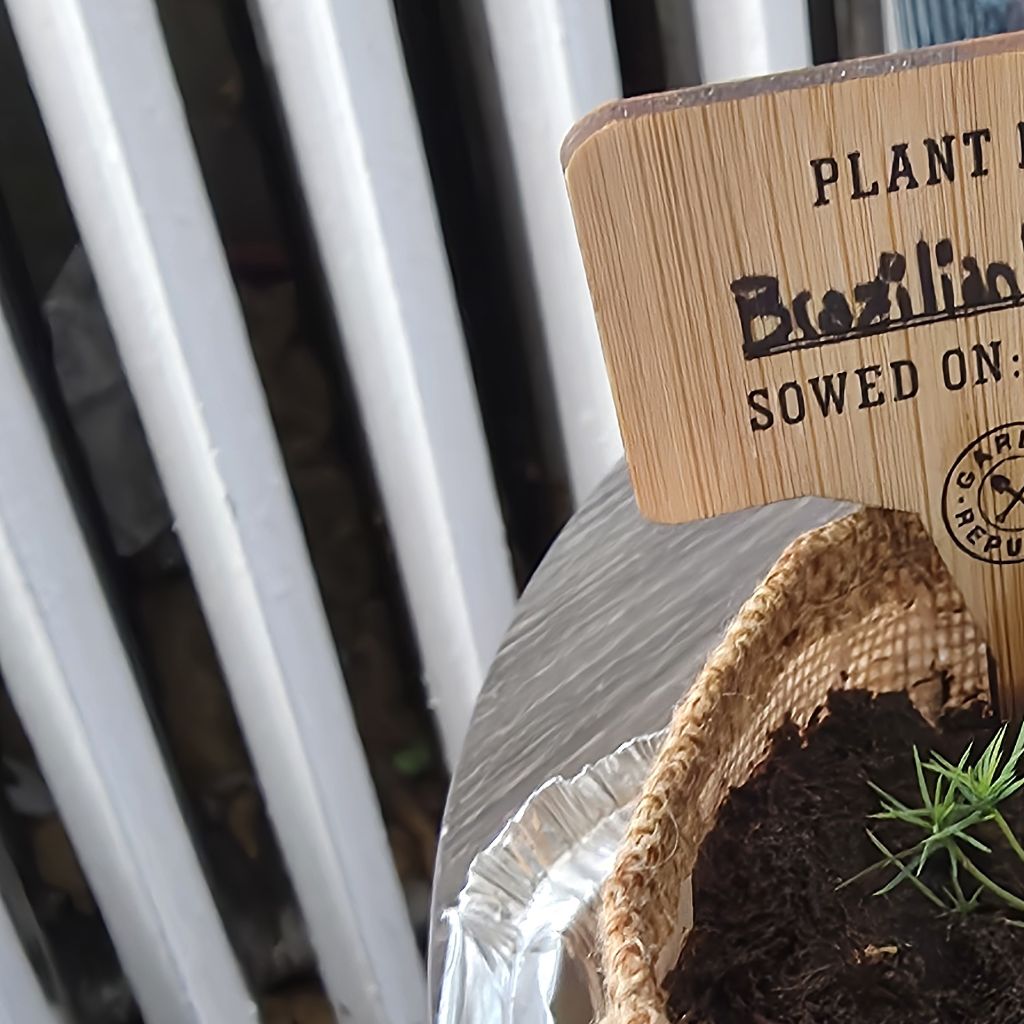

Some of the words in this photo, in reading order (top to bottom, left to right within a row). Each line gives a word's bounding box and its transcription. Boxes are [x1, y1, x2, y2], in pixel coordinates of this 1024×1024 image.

[810, 129, 991, 207] PLANT
[730, 236, 1021, 359] Brazilian
[746, 359, 920, 433] SOWED
[941, 340, 1022, 392] ON:
